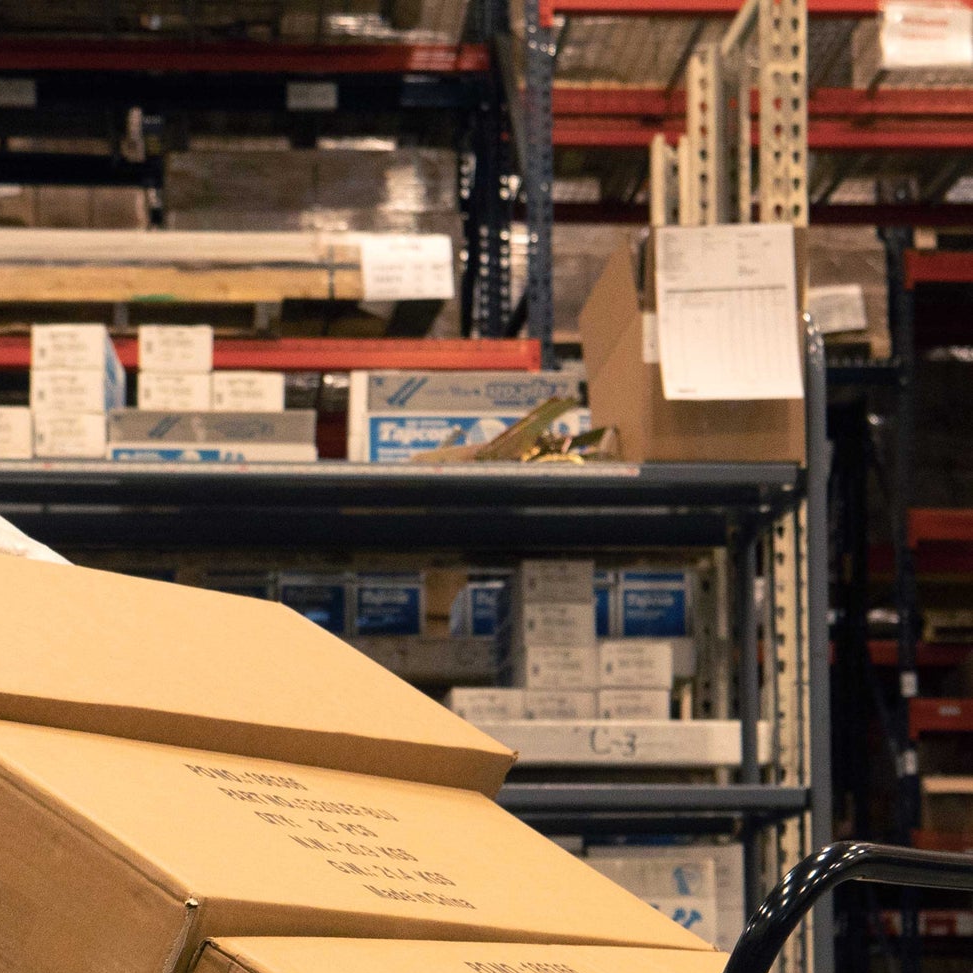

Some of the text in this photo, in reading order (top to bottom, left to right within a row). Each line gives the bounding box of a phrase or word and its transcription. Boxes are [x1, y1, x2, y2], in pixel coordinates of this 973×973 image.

[183, 763, 217, 778] PO
[217, 787, 268, 804] PART
[253, 811, 379, 838] QTY: 20 PCS
[376, 846, 419, 862] KGS
[413, 870, 457, 887] KGS
[363, 884, 417, 902] Made
[423, 891, 477, 910] China
